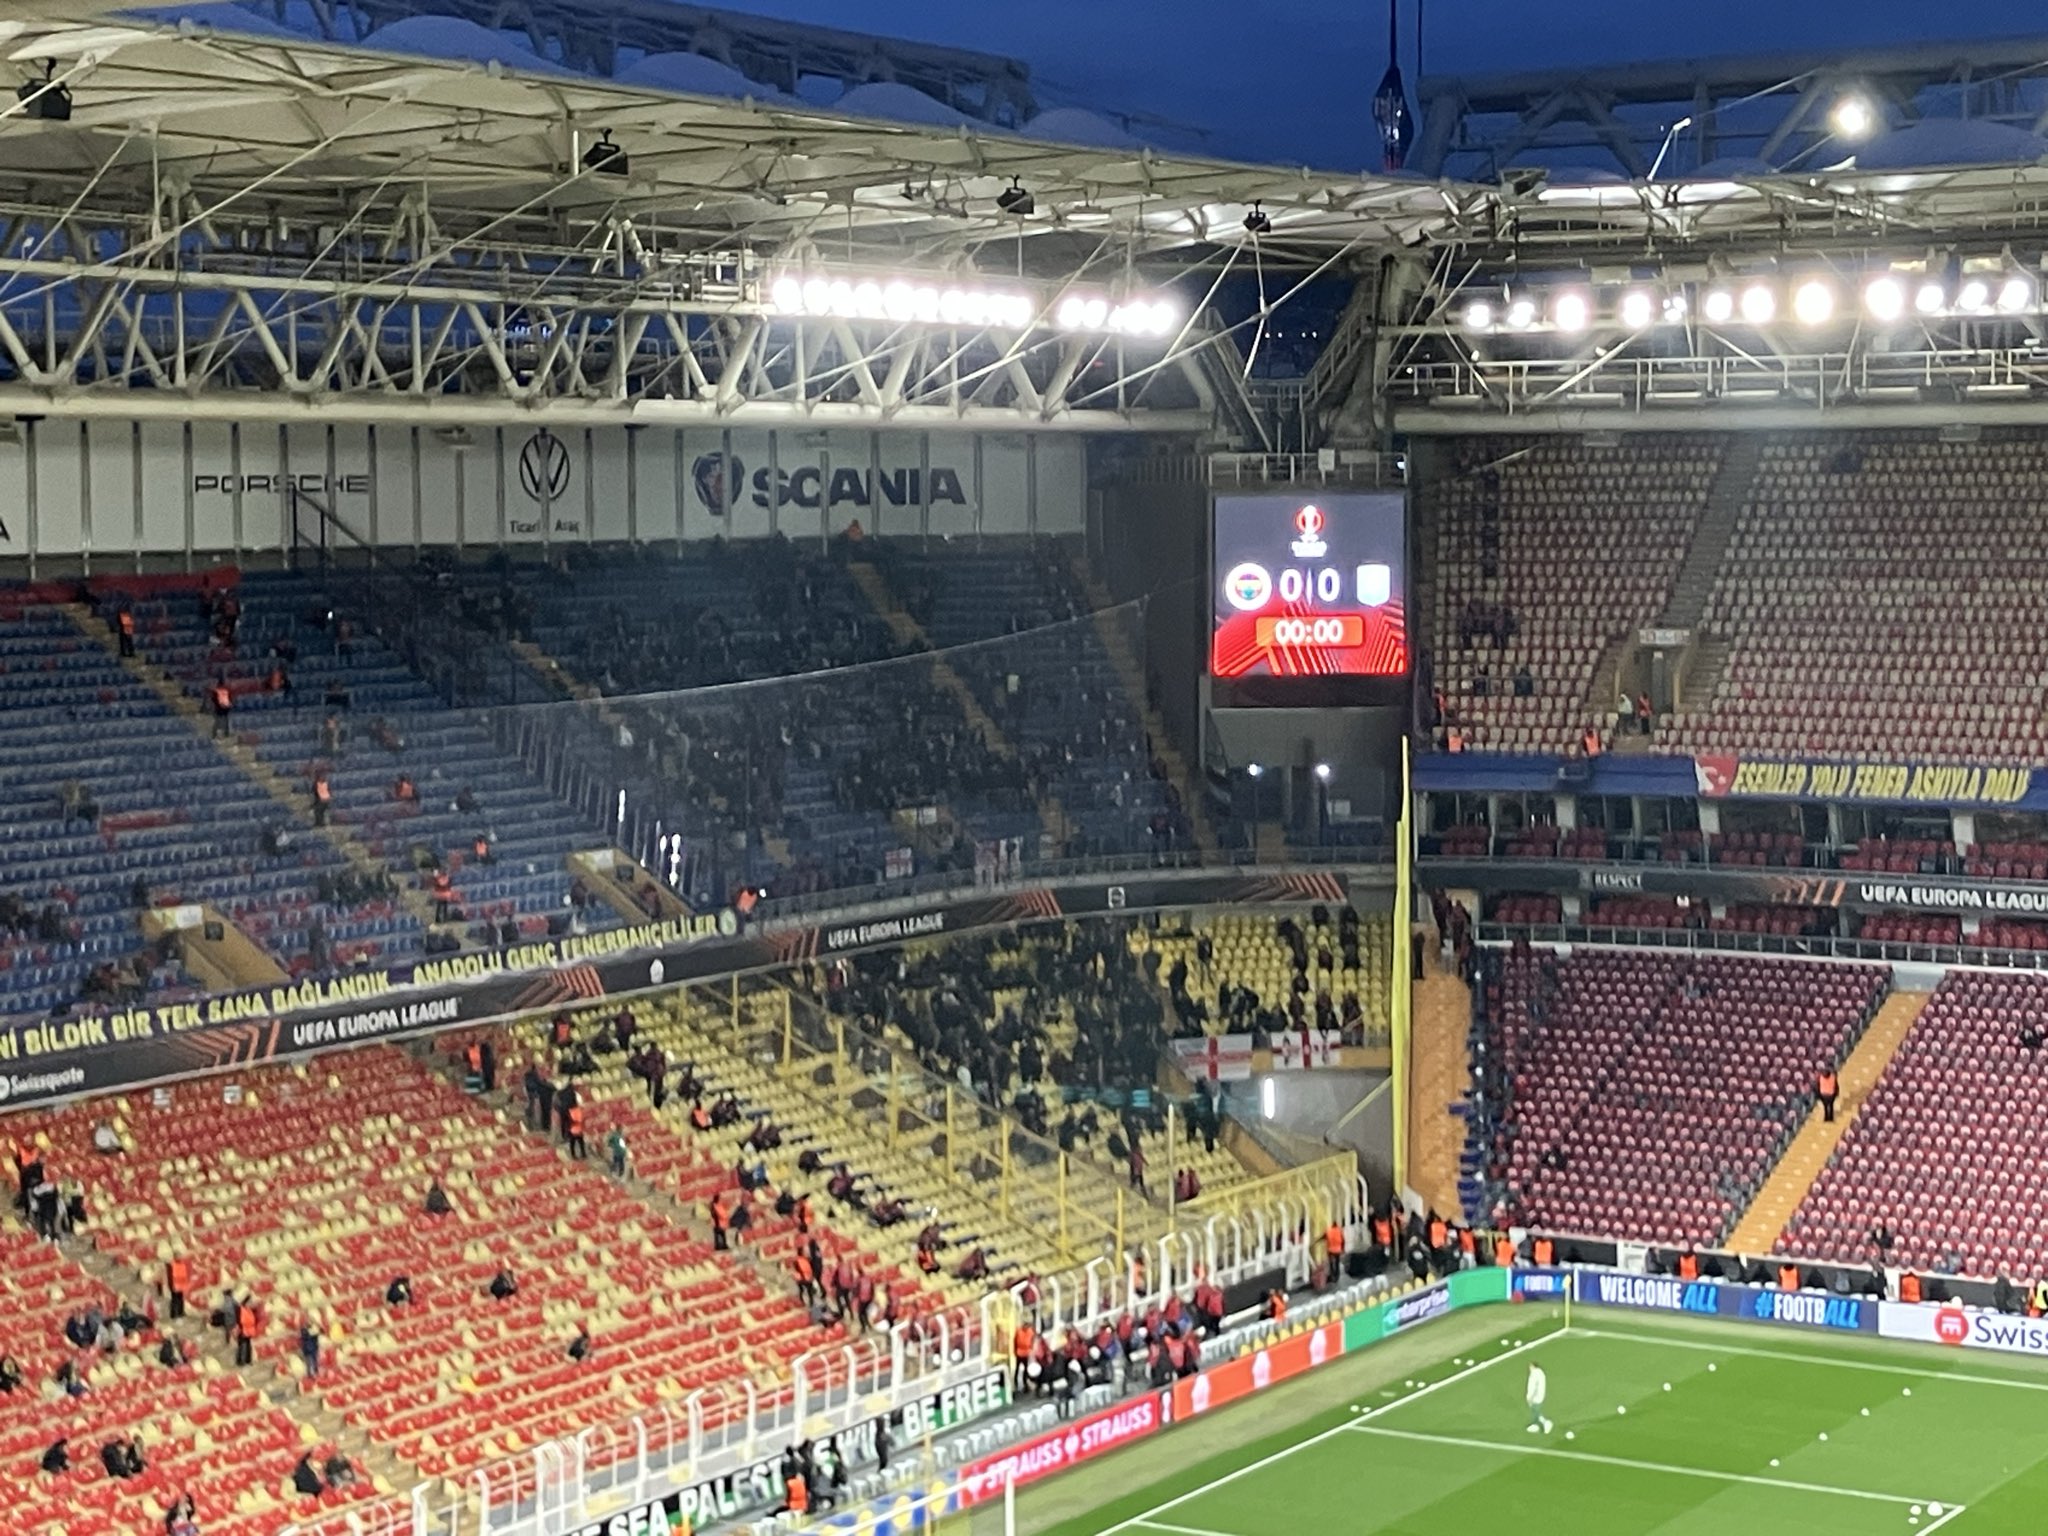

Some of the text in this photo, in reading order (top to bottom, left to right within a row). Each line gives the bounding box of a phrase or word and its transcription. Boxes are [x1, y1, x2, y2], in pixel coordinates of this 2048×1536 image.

[195, 475, 371, 493] PORSCHE
[752, 466, 967, 507] SCANIA
[1280, 568, 1340, 602] 0 0
[1275, 619, 1343, 645] 00:00
[1861, 884, 1908, 904] UEFA
[1911, 887, 1982, 907] EUROPA
[828, 911, 943, 949] UEFA EUROPA LEAGUE
[111, 1007, 153, 1042] BİR
[157, 1003, 204, 1034] TEK
[208, 992, 270, 1023] SANA
[413, 950, 502, 987] ANADOLU
[506, 941, 558, 969] GENÇ
[293, 997, 459, 1046] UEFA EUROPA LEAGUE
[1600, 1275, 1718, 1313] WELCOME ALL
[1755, 1291, 1860, 1328] #FOOTBALL
[903, 1399, 937, 1439] BE
[940, 1373, 1003, 1425] FREE
[985, 1402, 1153, 1490] STRAUSS STRAUSS
